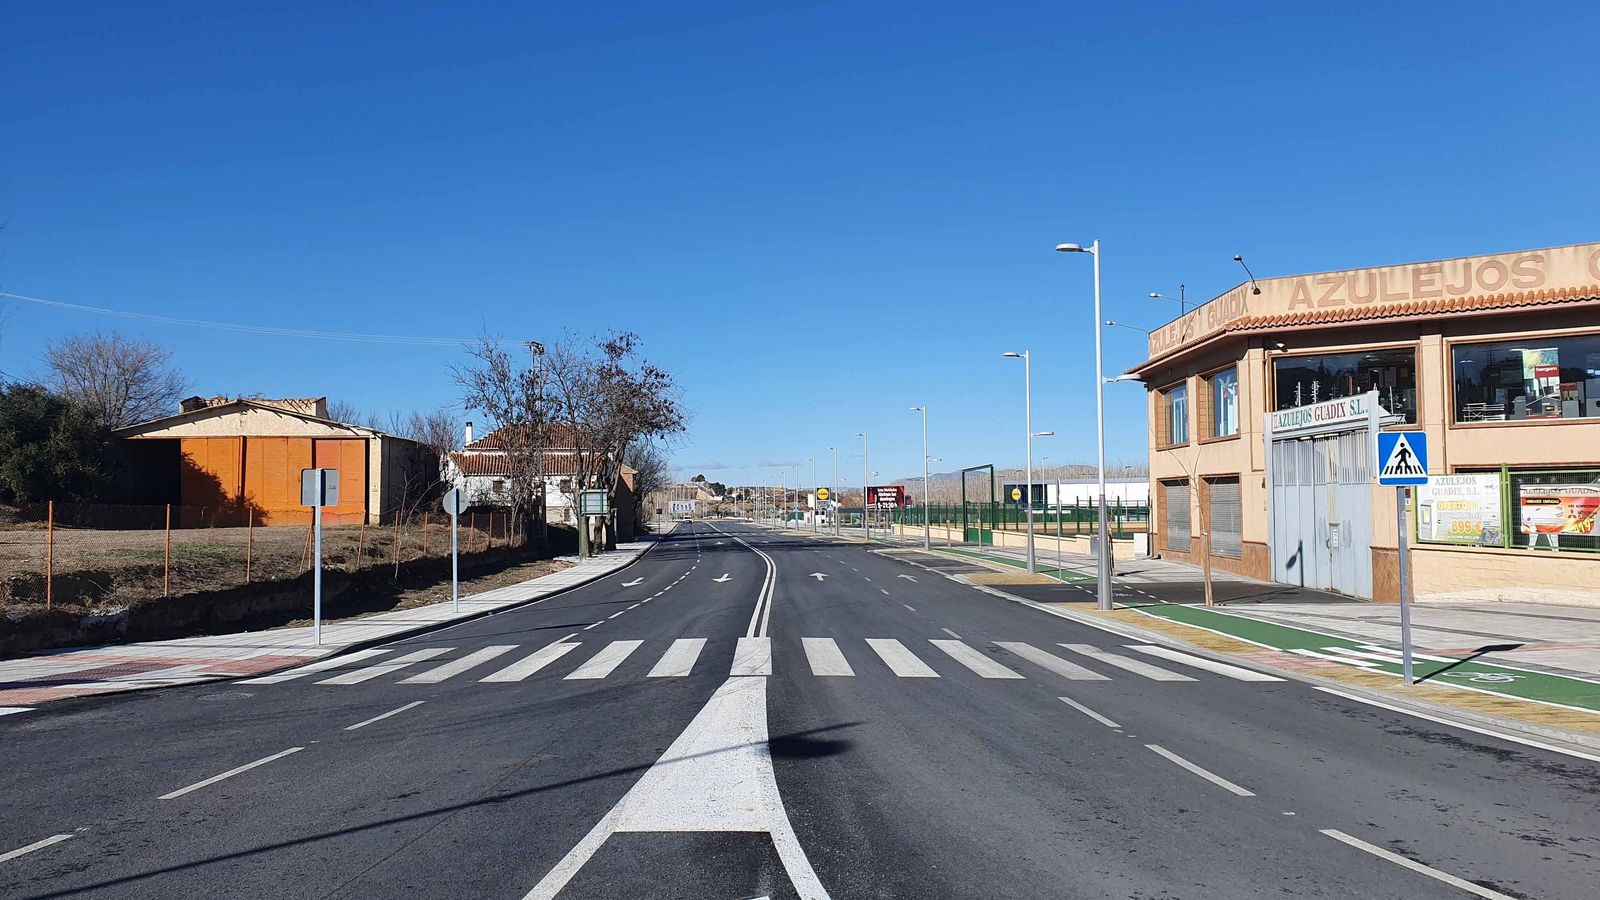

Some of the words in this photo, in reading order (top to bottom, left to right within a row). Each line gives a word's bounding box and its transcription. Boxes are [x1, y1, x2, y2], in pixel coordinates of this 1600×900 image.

[1288, 254, 1546, 310] AZULEJOS
[1207, 286, 1248, 330] GUADIX
[1278, 408, 1312, 428] AZULEJOS
[1314, 401, 1346, 422] GUADIX
[1435, 477, 1477, 486] AZULEJOS
[1451, 519, 1473, 534] 699
